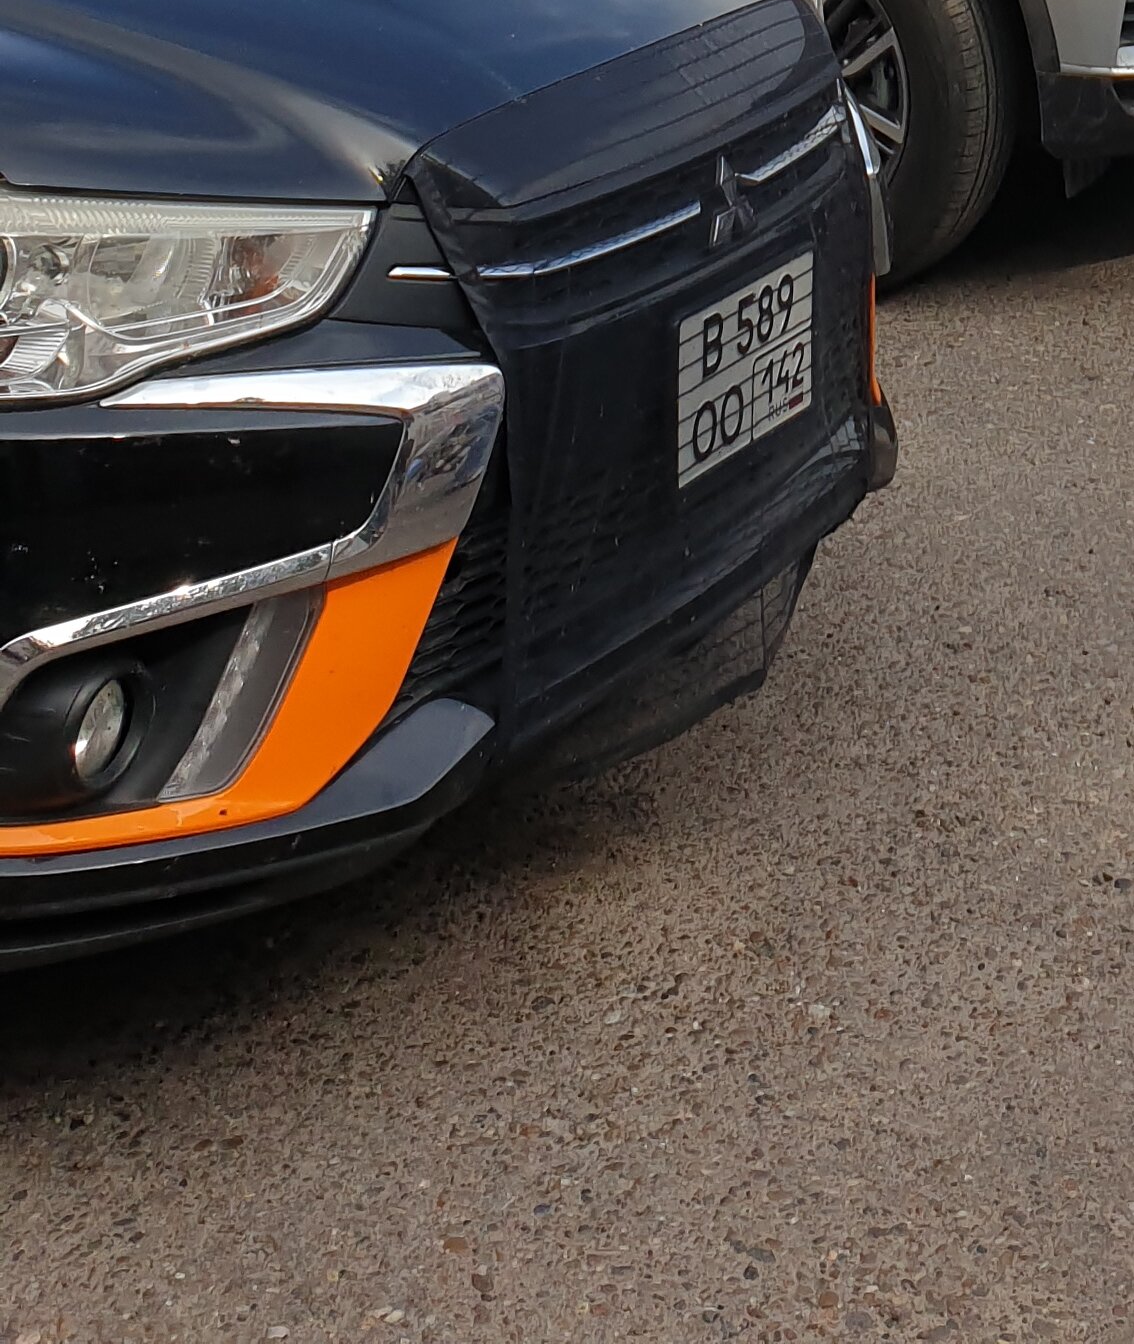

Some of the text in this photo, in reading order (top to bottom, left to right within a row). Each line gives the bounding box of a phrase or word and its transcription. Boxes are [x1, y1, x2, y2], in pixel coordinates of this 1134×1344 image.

[737, 273, 794, 355] 589
[761, 342, 805, 403] 142
[767, 396, 789, 422] RUS
